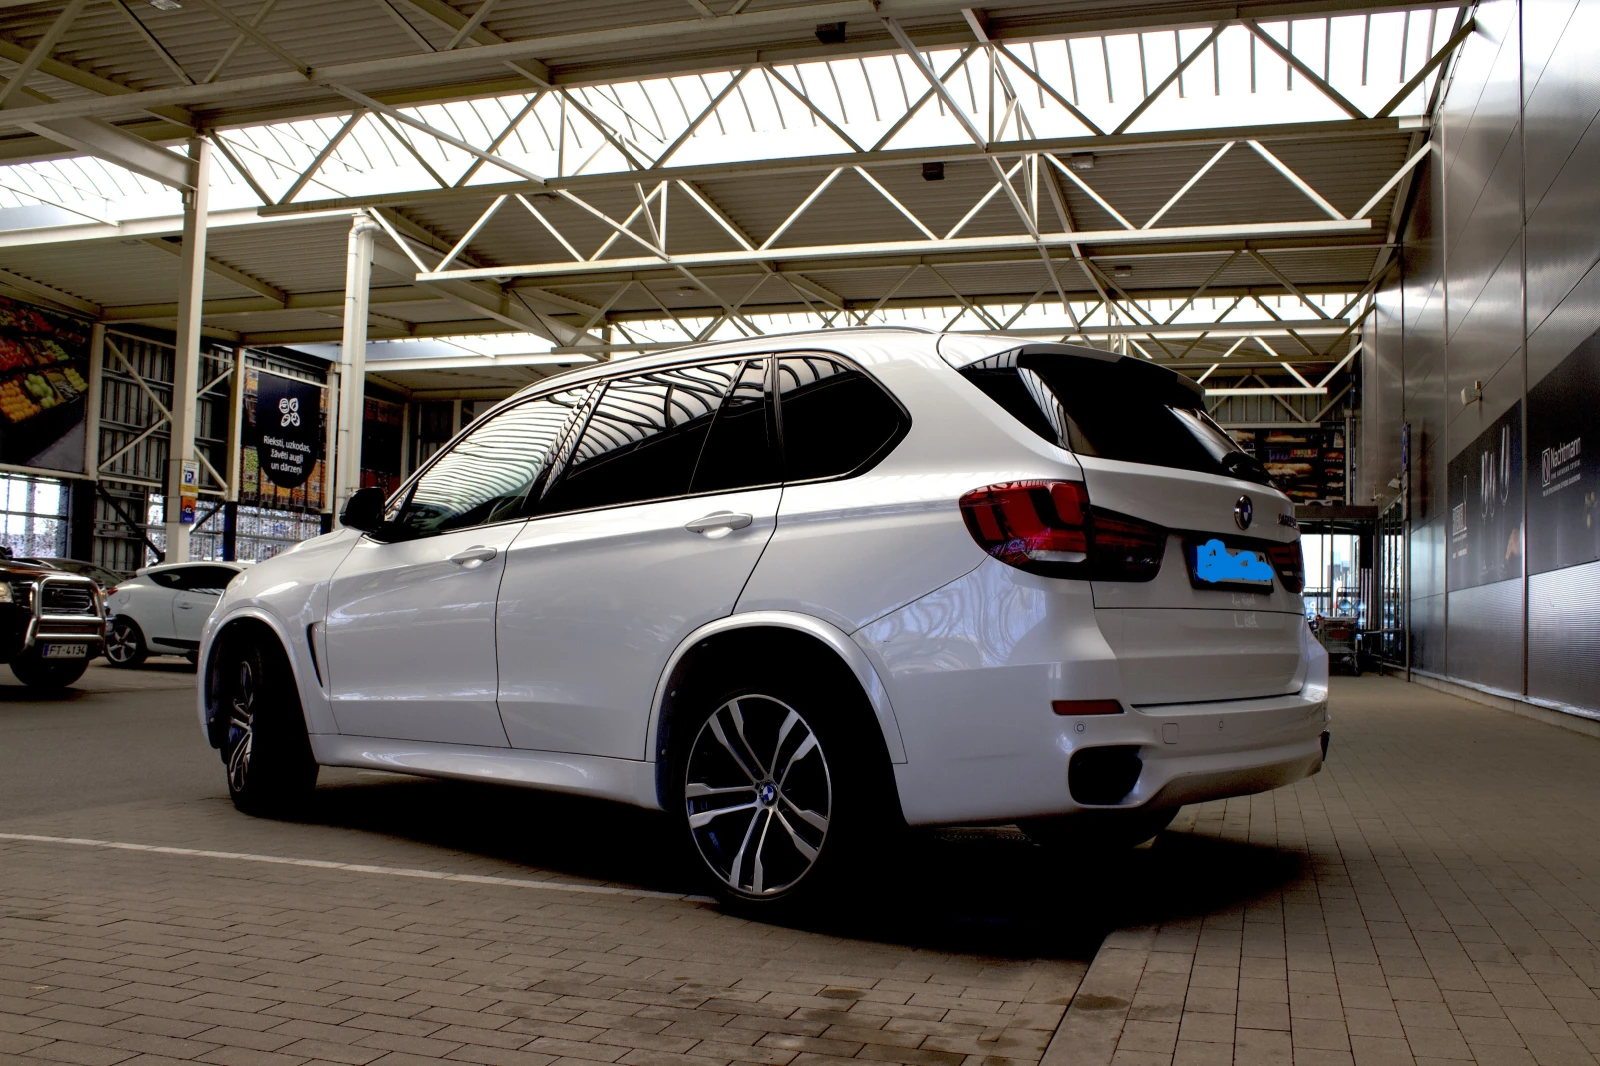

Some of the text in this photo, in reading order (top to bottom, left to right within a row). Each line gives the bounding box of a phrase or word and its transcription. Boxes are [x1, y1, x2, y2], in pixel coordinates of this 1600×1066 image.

[263, 435, 312, 454] Rieksti, uzkodas,
[270, 449, 304, 465] žāvēti augļi
[1550, 437, 1581, 469] Nachtmann
[270, 462, 303, 475] un dārzeņi
[49, 645, 86, 655] FT-4134
